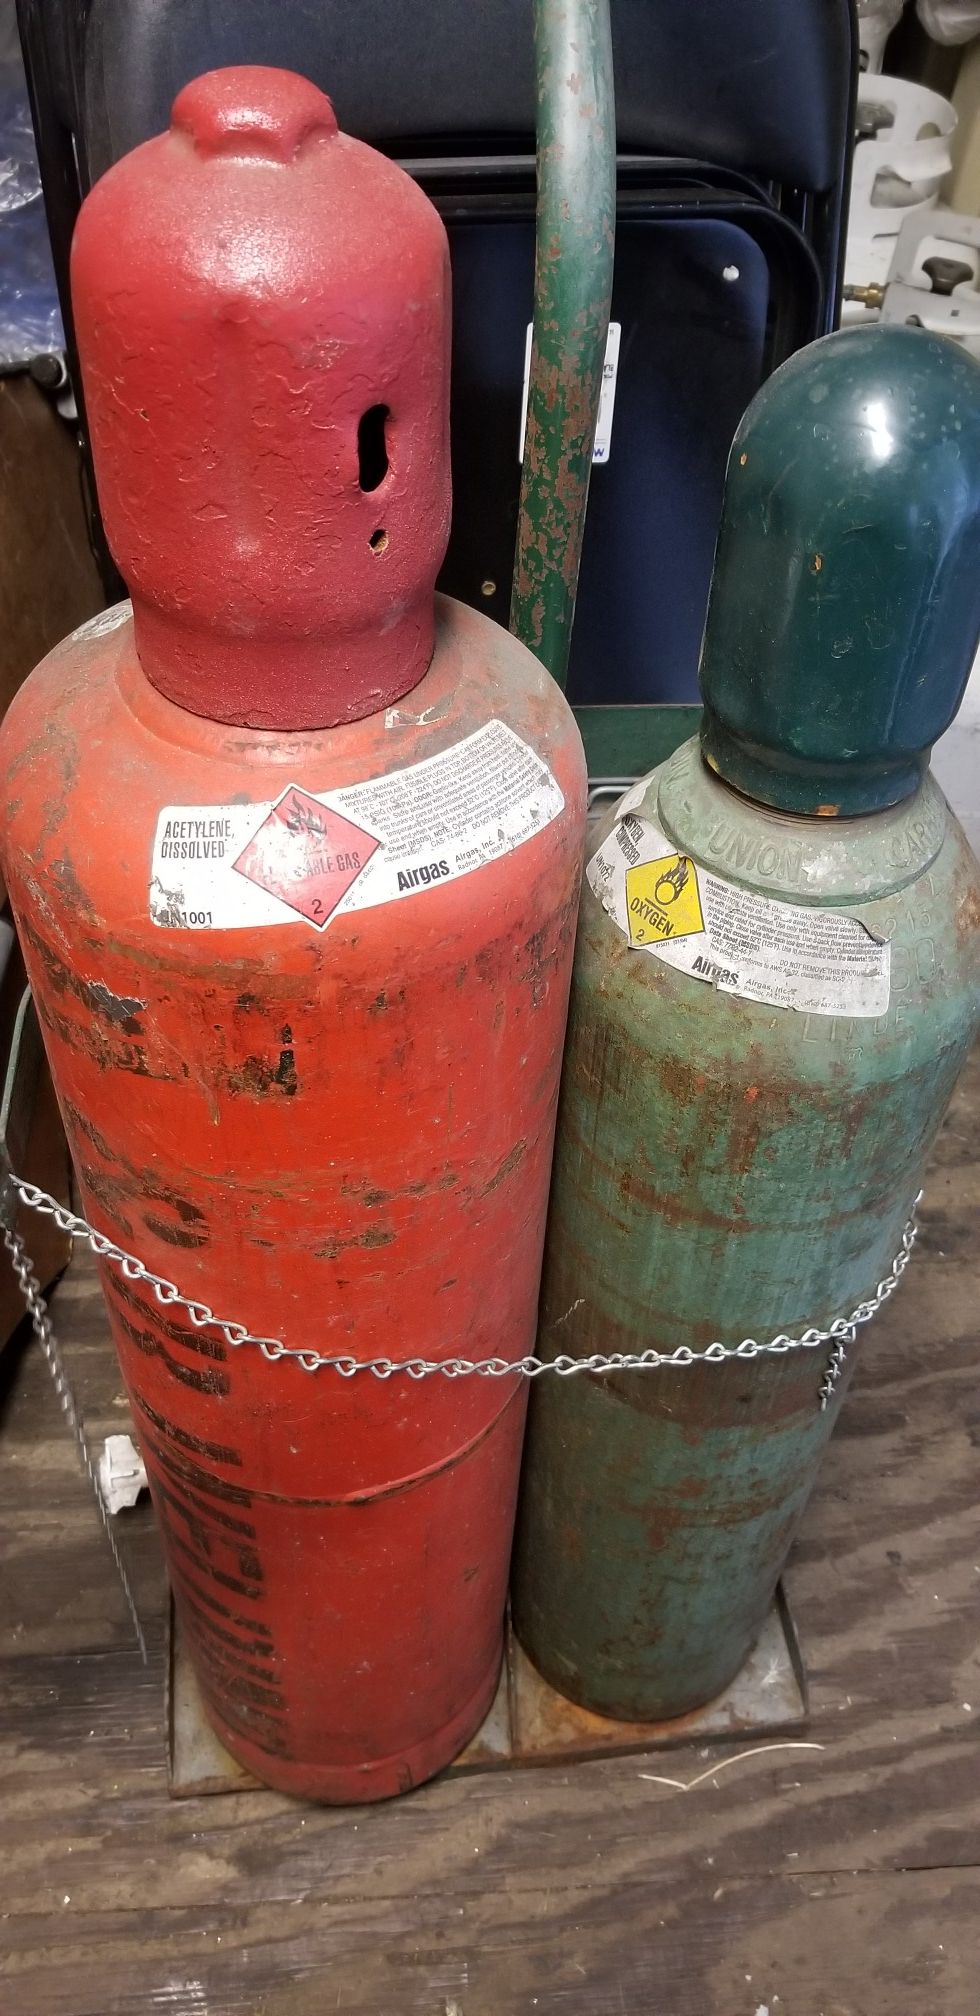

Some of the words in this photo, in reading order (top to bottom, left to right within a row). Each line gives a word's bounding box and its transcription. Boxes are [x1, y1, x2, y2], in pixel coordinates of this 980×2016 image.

[366, 778, 401, 794] FLAMMABLE
[401, 773, 414, 782] GAS
[413, 790, 433, 802] ODOR:
[164, 819, 235, 839] ACETYLENE,
[161, 840, 225, 859] DISSOLVED
[388, 842, 407, 853] Sheet
[615, 825, 641, 866] COMPRESSED
[707, 821, 802, 883] UNION
[336, 851, 361, 872] GAS
[396, 860, 450, 892] Airgas
[311, 898, 324, 915] 2
[630, 896, 675, 937] OXYGEN
[635, 928, 645, 942] 2
[690, 955, 740, 986] Airgas
[770, 964, 782, 972] AWS
[802, 965, 828, 974] REMOVE
[745, 979, 771, 991] Airgas,
